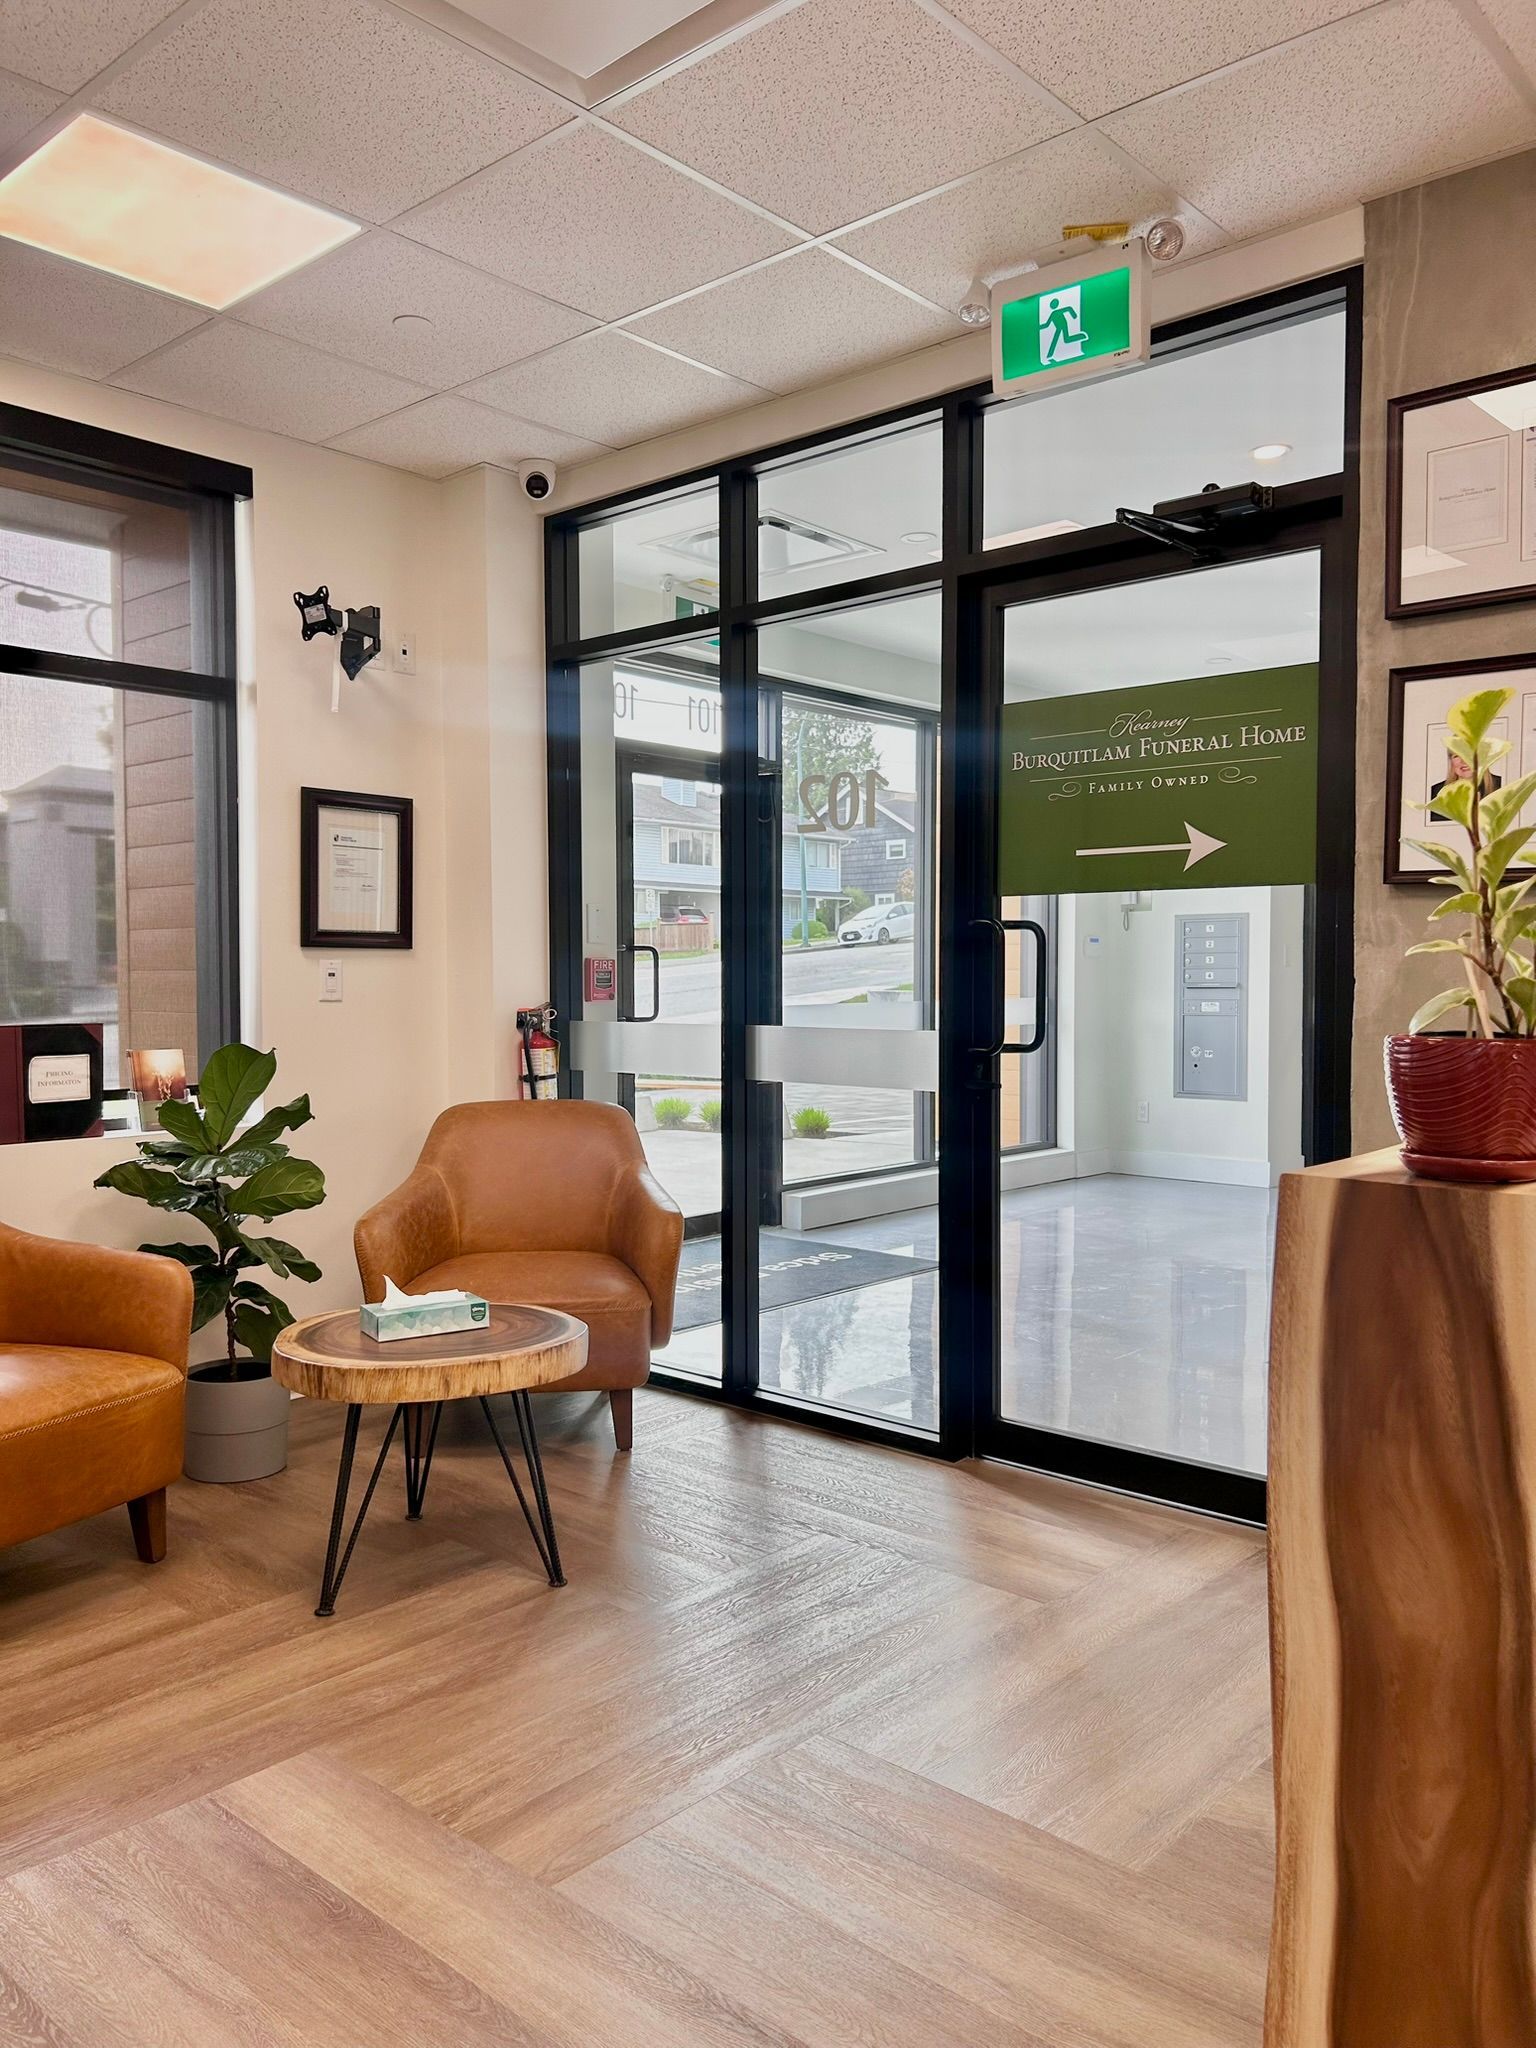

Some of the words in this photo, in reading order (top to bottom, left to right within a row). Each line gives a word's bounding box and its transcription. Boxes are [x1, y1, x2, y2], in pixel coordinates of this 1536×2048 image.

[1109, 709, 1190, 738] Kearney
[1011, 745, 1131, 771] BURQUITLAM
[1139, 734, 1232, 757] FUNERAL
[1240, 725, 1306, 748] HOME
[1089, 780, 1144, 794] FAMILY
[1151, 774, 1209, 788] OWNED
[594, 960, 613, 970] FIRE
